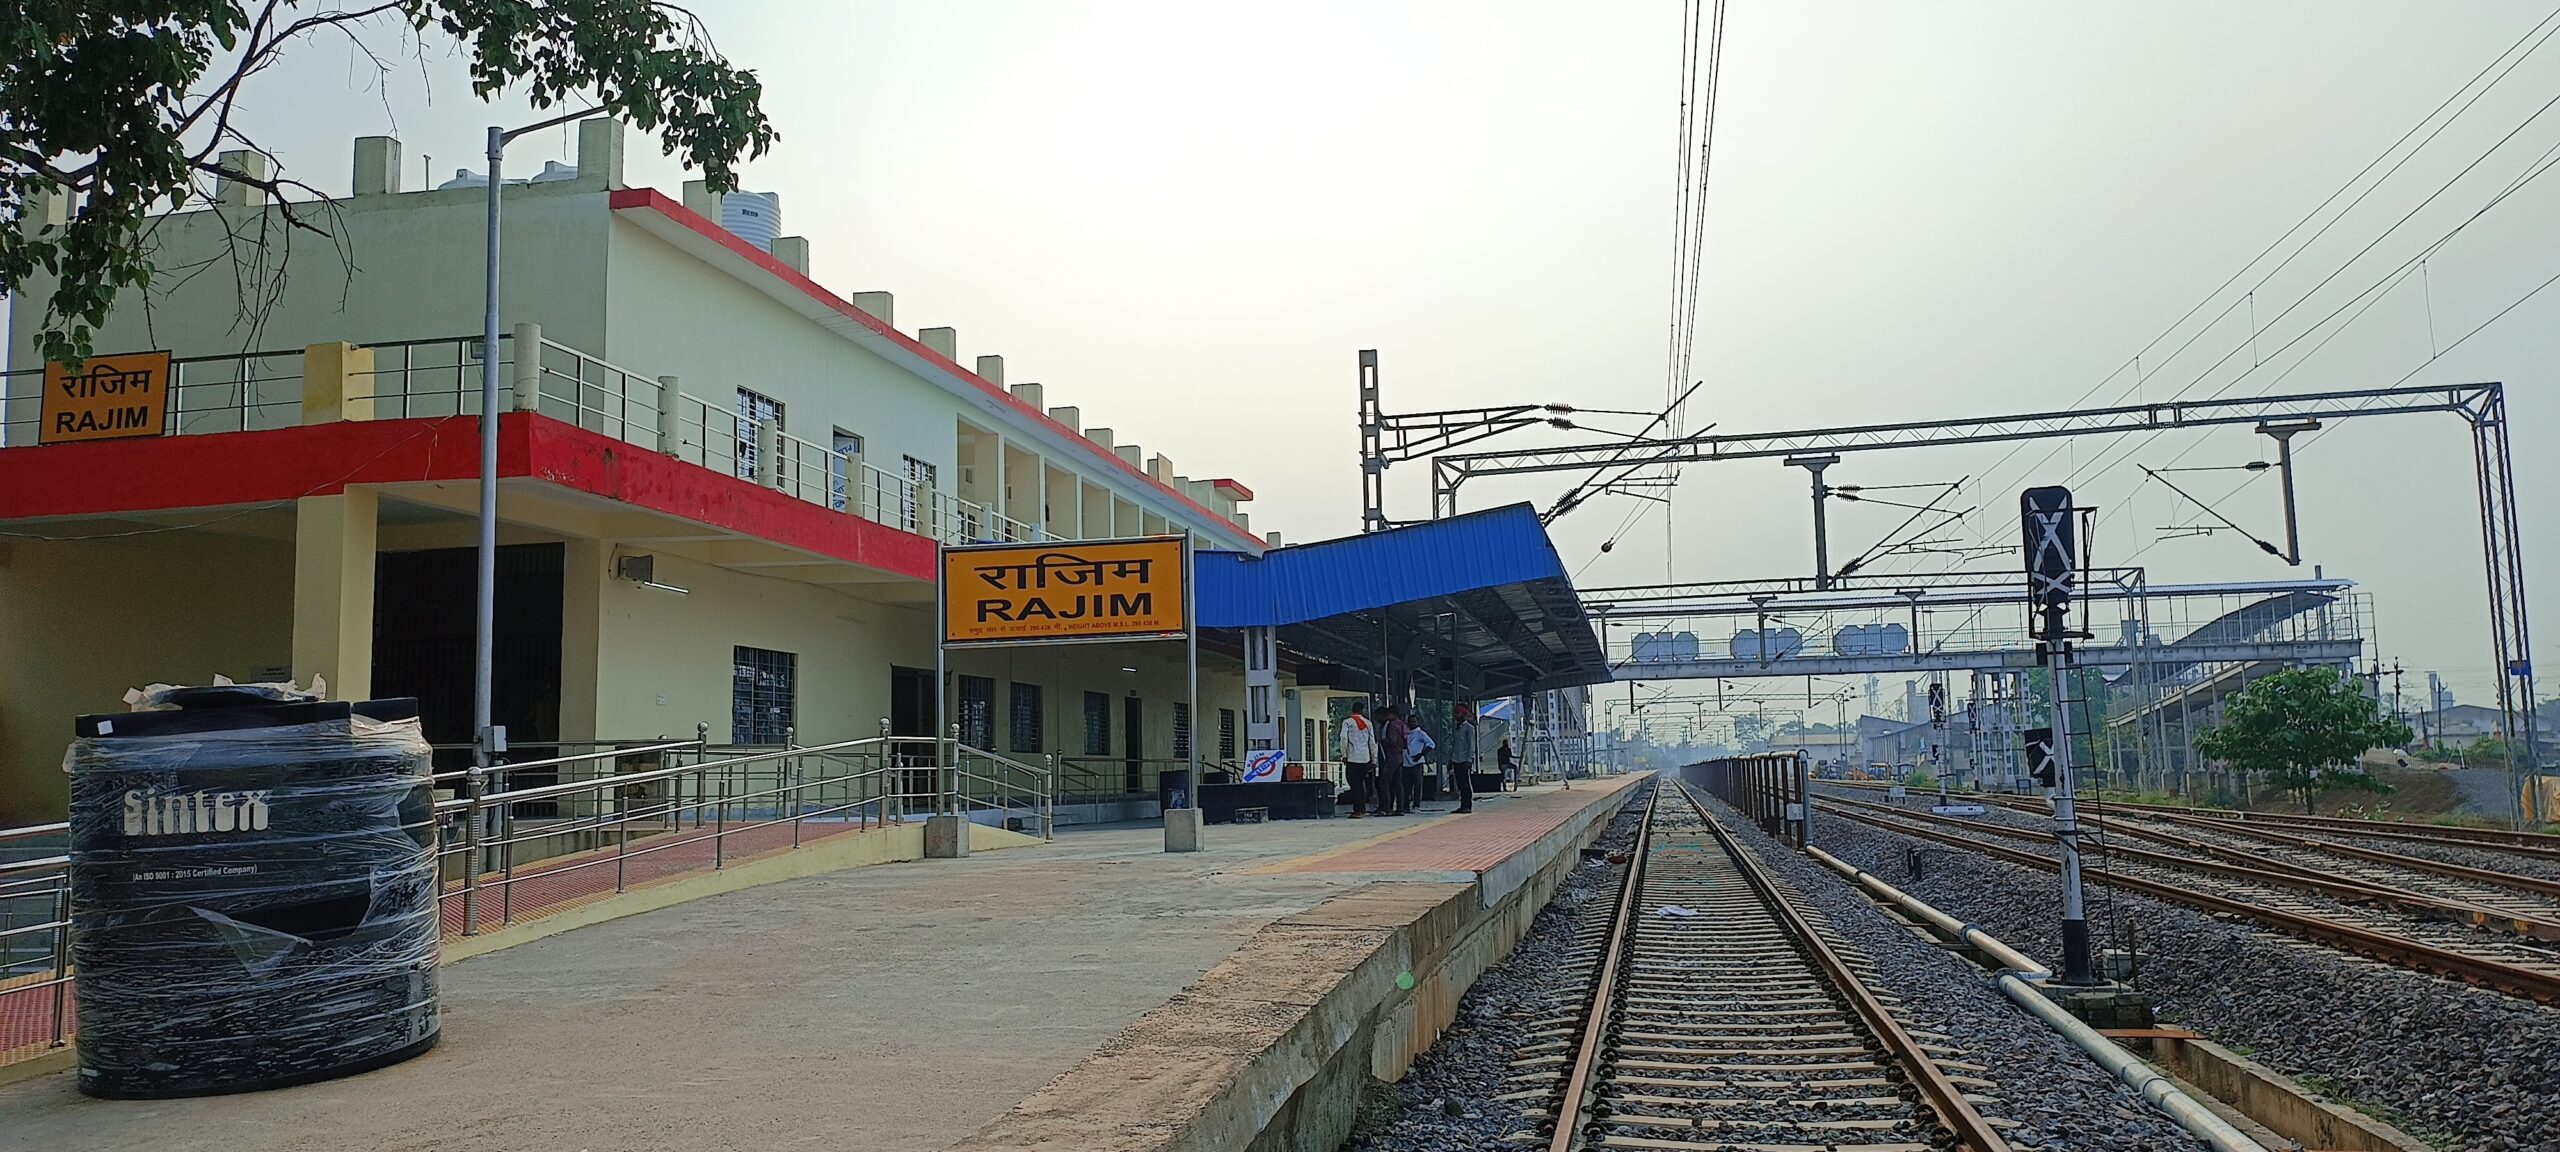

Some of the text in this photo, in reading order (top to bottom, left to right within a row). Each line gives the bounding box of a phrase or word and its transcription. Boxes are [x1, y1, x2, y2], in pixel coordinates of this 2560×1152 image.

[60, 364, 152, 398] राजिम
[56, 406, 148, 434] RAJIM
[974, 553, 1153, 590] राजिम
[977, 593, 1152, 622] RAJIM
[123, 787, 269, 836] Sintex
[143, 871, 154, 880] ISO
[155, 871, 170, 880] 9001
[175, 869, 192, 879] 2015
[192, 866, 222, 878] Certified
[223, 864, 258, 876] Company)
